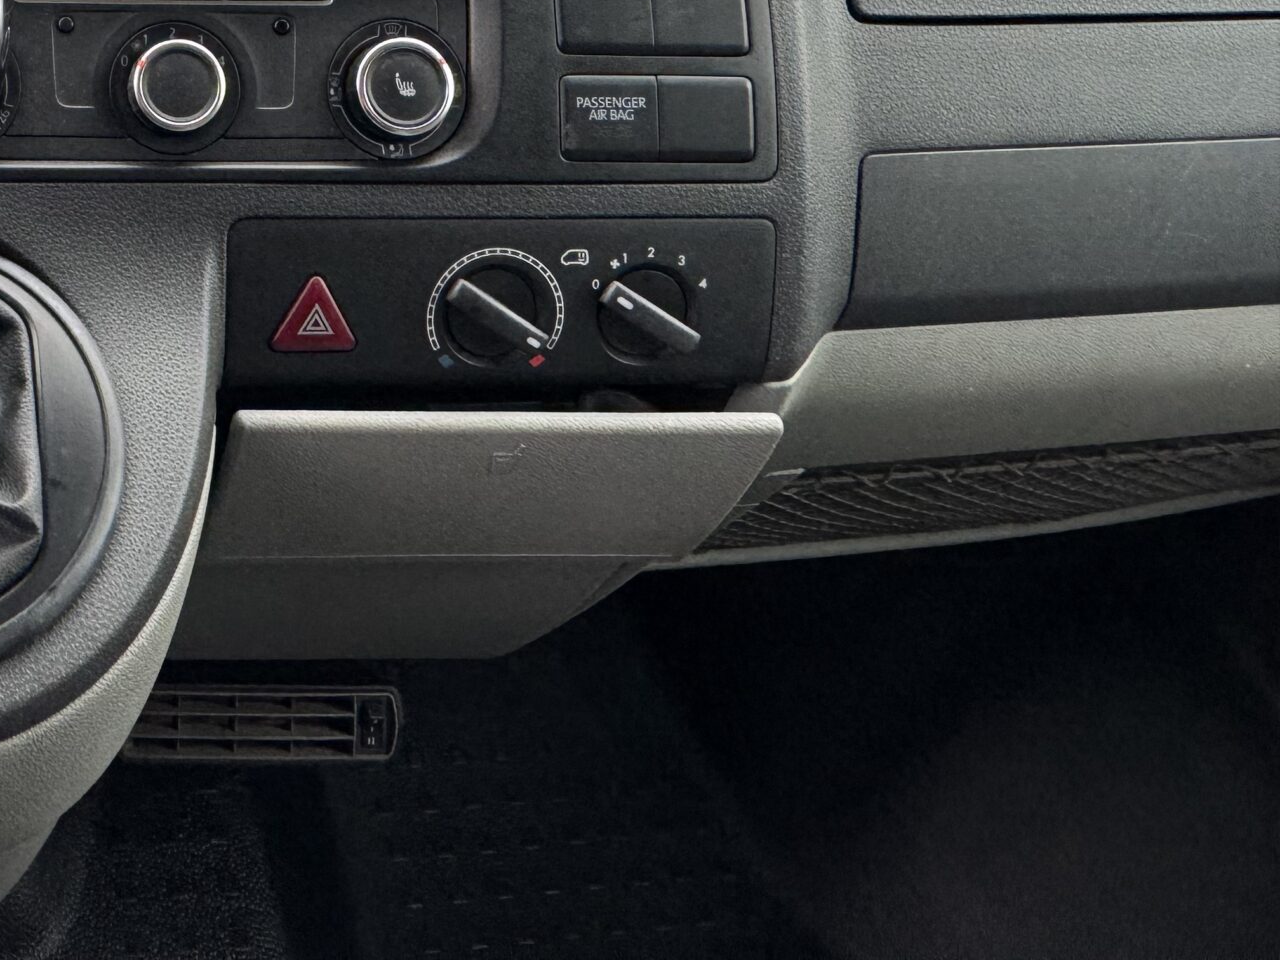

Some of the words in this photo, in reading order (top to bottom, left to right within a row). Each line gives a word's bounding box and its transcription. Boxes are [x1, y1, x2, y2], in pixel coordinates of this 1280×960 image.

[575, 96, 647, 109] PASSENGER
[588, 109, 608, 121] AIR
[609, 109, 635, 121] BAG
[647, 247, 655, 259] 2
[678, 255, 686, 266] 3
[591, 278, 600, 290] 0
[698, 278, 708, 289] 4
